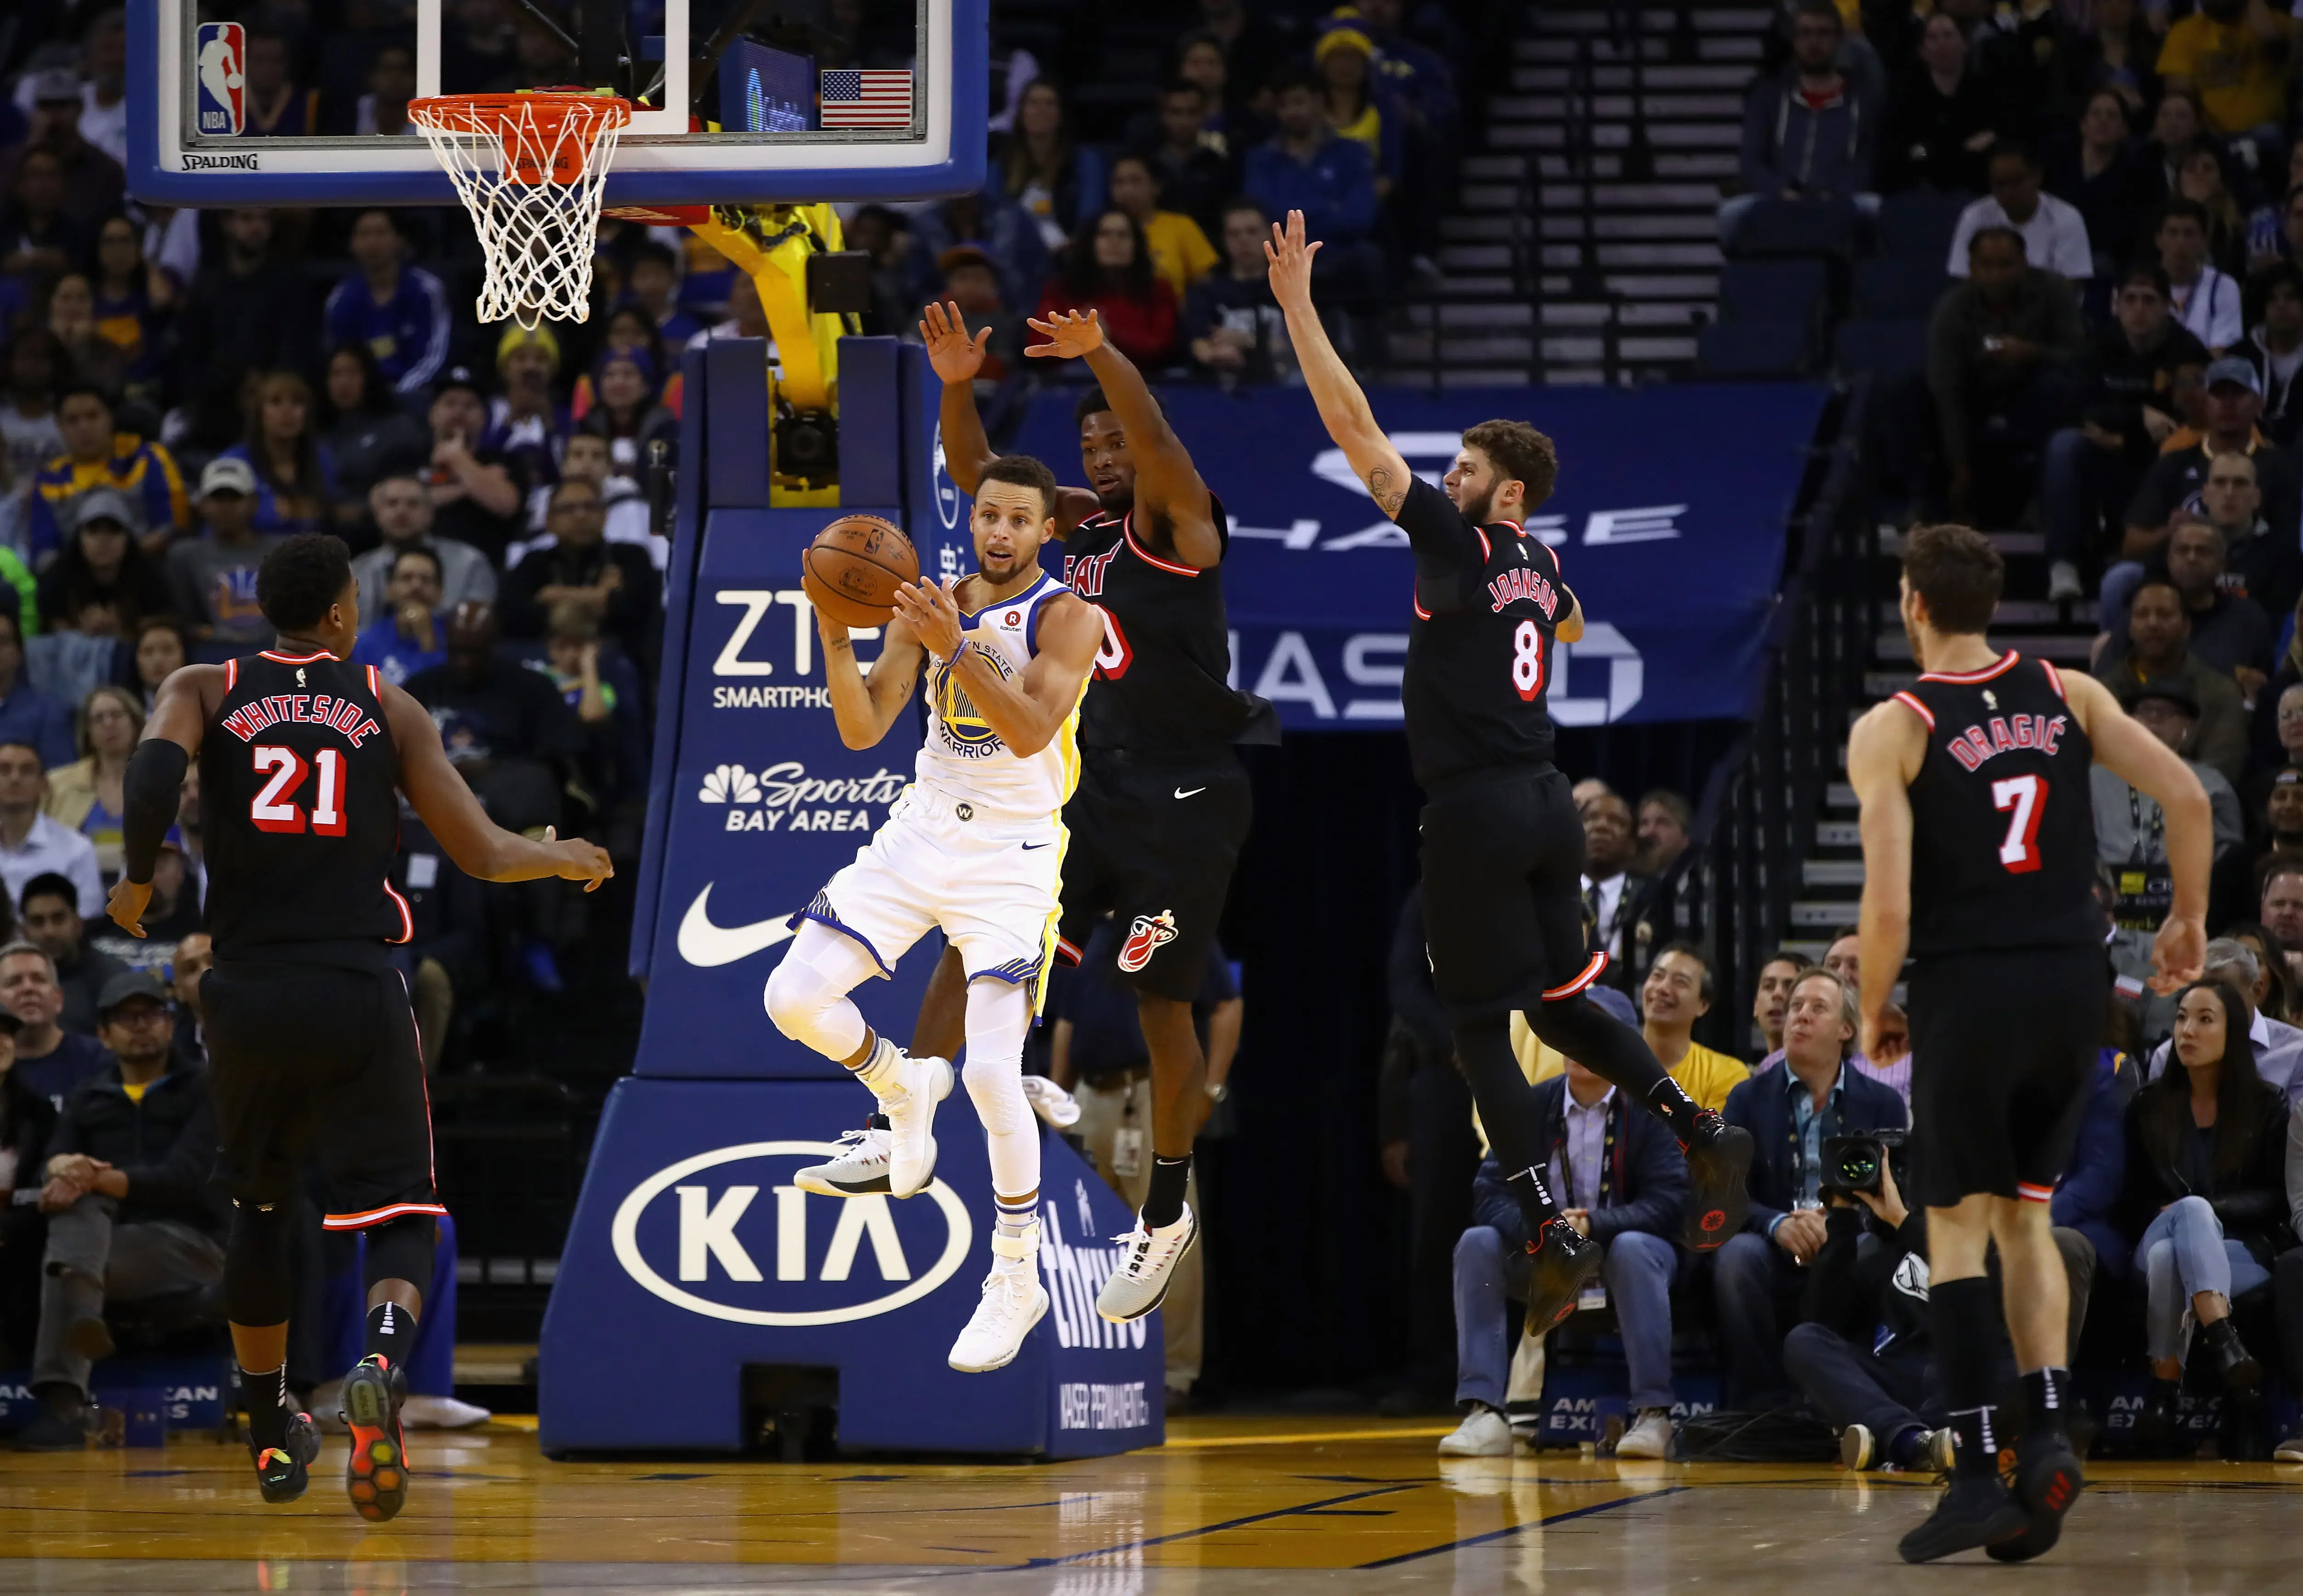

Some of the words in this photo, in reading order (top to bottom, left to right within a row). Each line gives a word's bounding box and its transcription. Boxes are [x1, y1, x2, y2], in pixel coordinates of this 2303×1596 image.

[202, 111, 227, 129] NBA
[182, 154, 259, 171] SPALDING
[1064, 538, 1124, 597] EAT
[1488, 568, 1558, 621] JOHNSON
[1009, 614, 1017, 624] R
[1091, 602, 1134, 681] 0
[984, 645, 1013, 676] STATE
[1512, 618, 1544, 702] 8
[221, 694, 381, 749] WHITESIDE
[940, 721, 1006, 758] WARRIOR
[1946, 714, 2068, 773] DRAGIĆ
[250, 744, 348, 837] 21
[760, 761, 906, 815] Sports
[958, 807, 971, 818] W
[725, 810, 785, 831] BAY
[788, 810, 870, 831] AREA
[1990, 772, 2050, 874] 7
[675, 1185, 912, 1282] KIA
